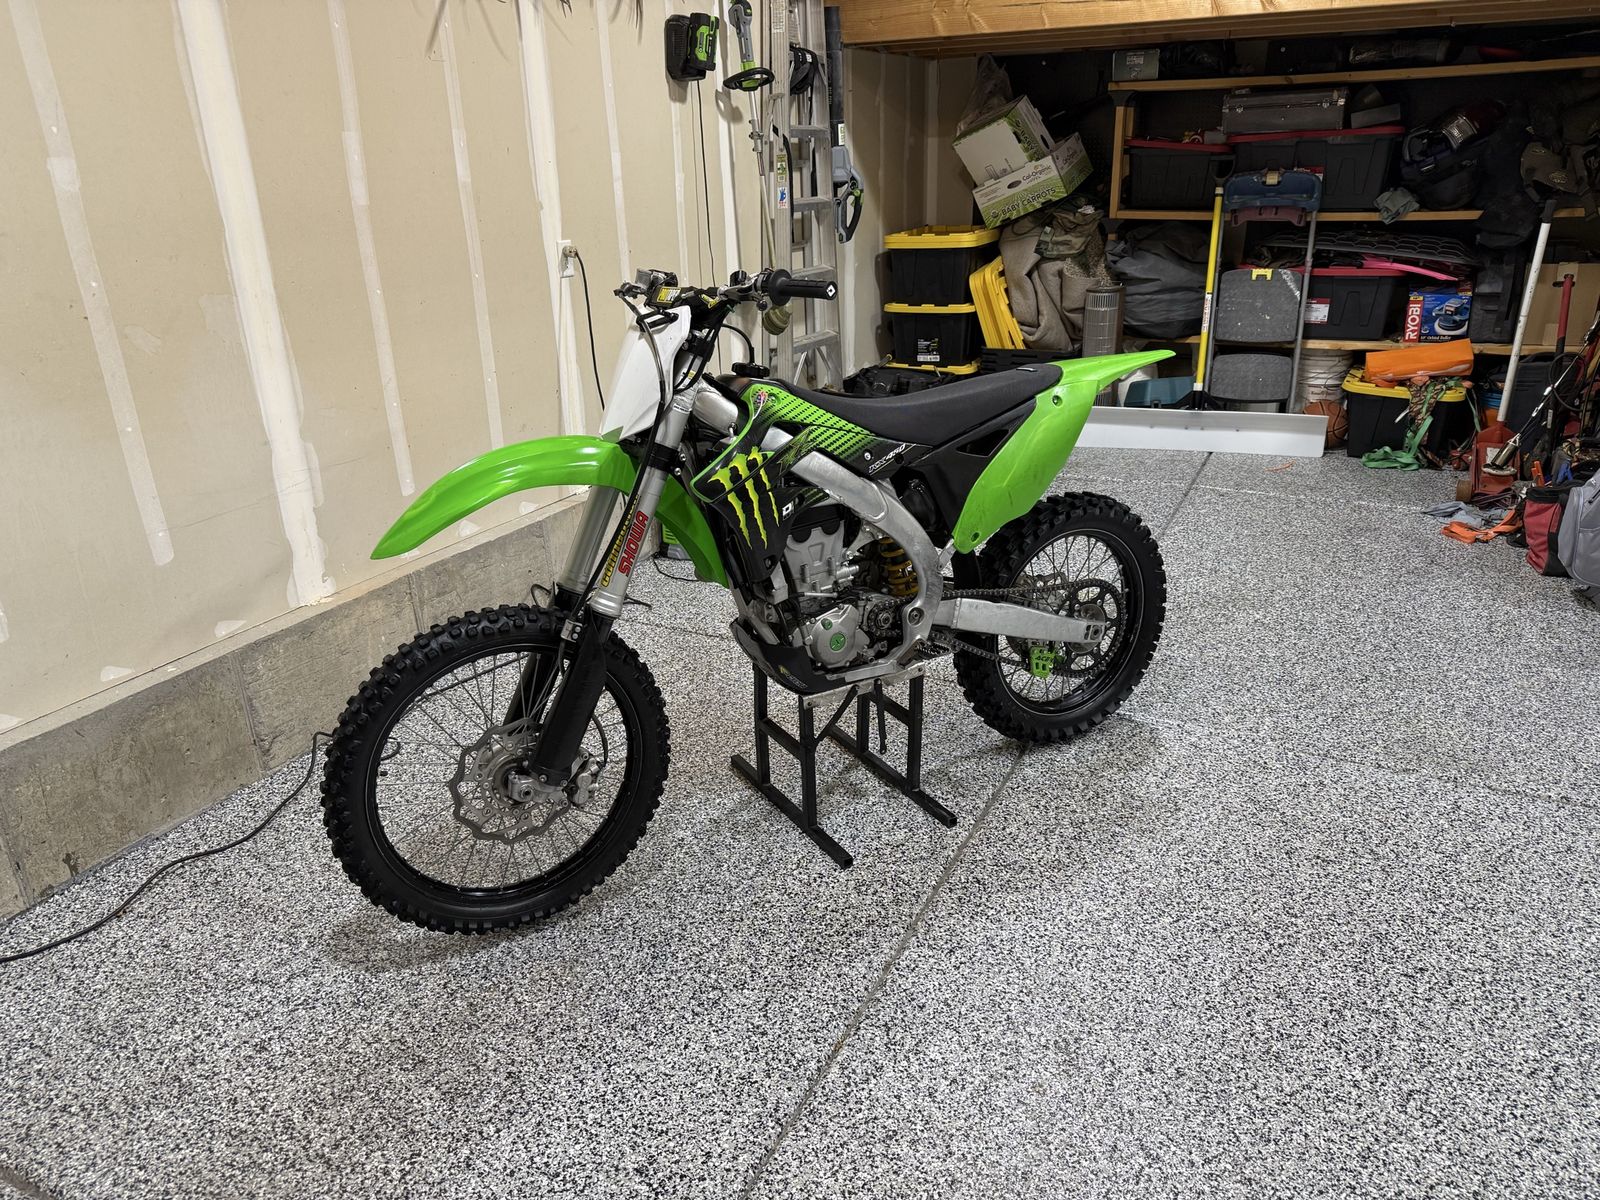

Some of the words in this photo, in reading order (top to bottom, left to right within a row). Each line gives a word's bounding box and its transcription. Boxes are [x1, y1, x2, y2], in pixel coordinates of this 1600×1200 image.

[1001, 203, 1021, 216] BABY
[1021, 187, 1056, 206] CARROTS
[1405, 304, 1421, 340] RYOBI
[618, 511, 649, 577] SHOWA
